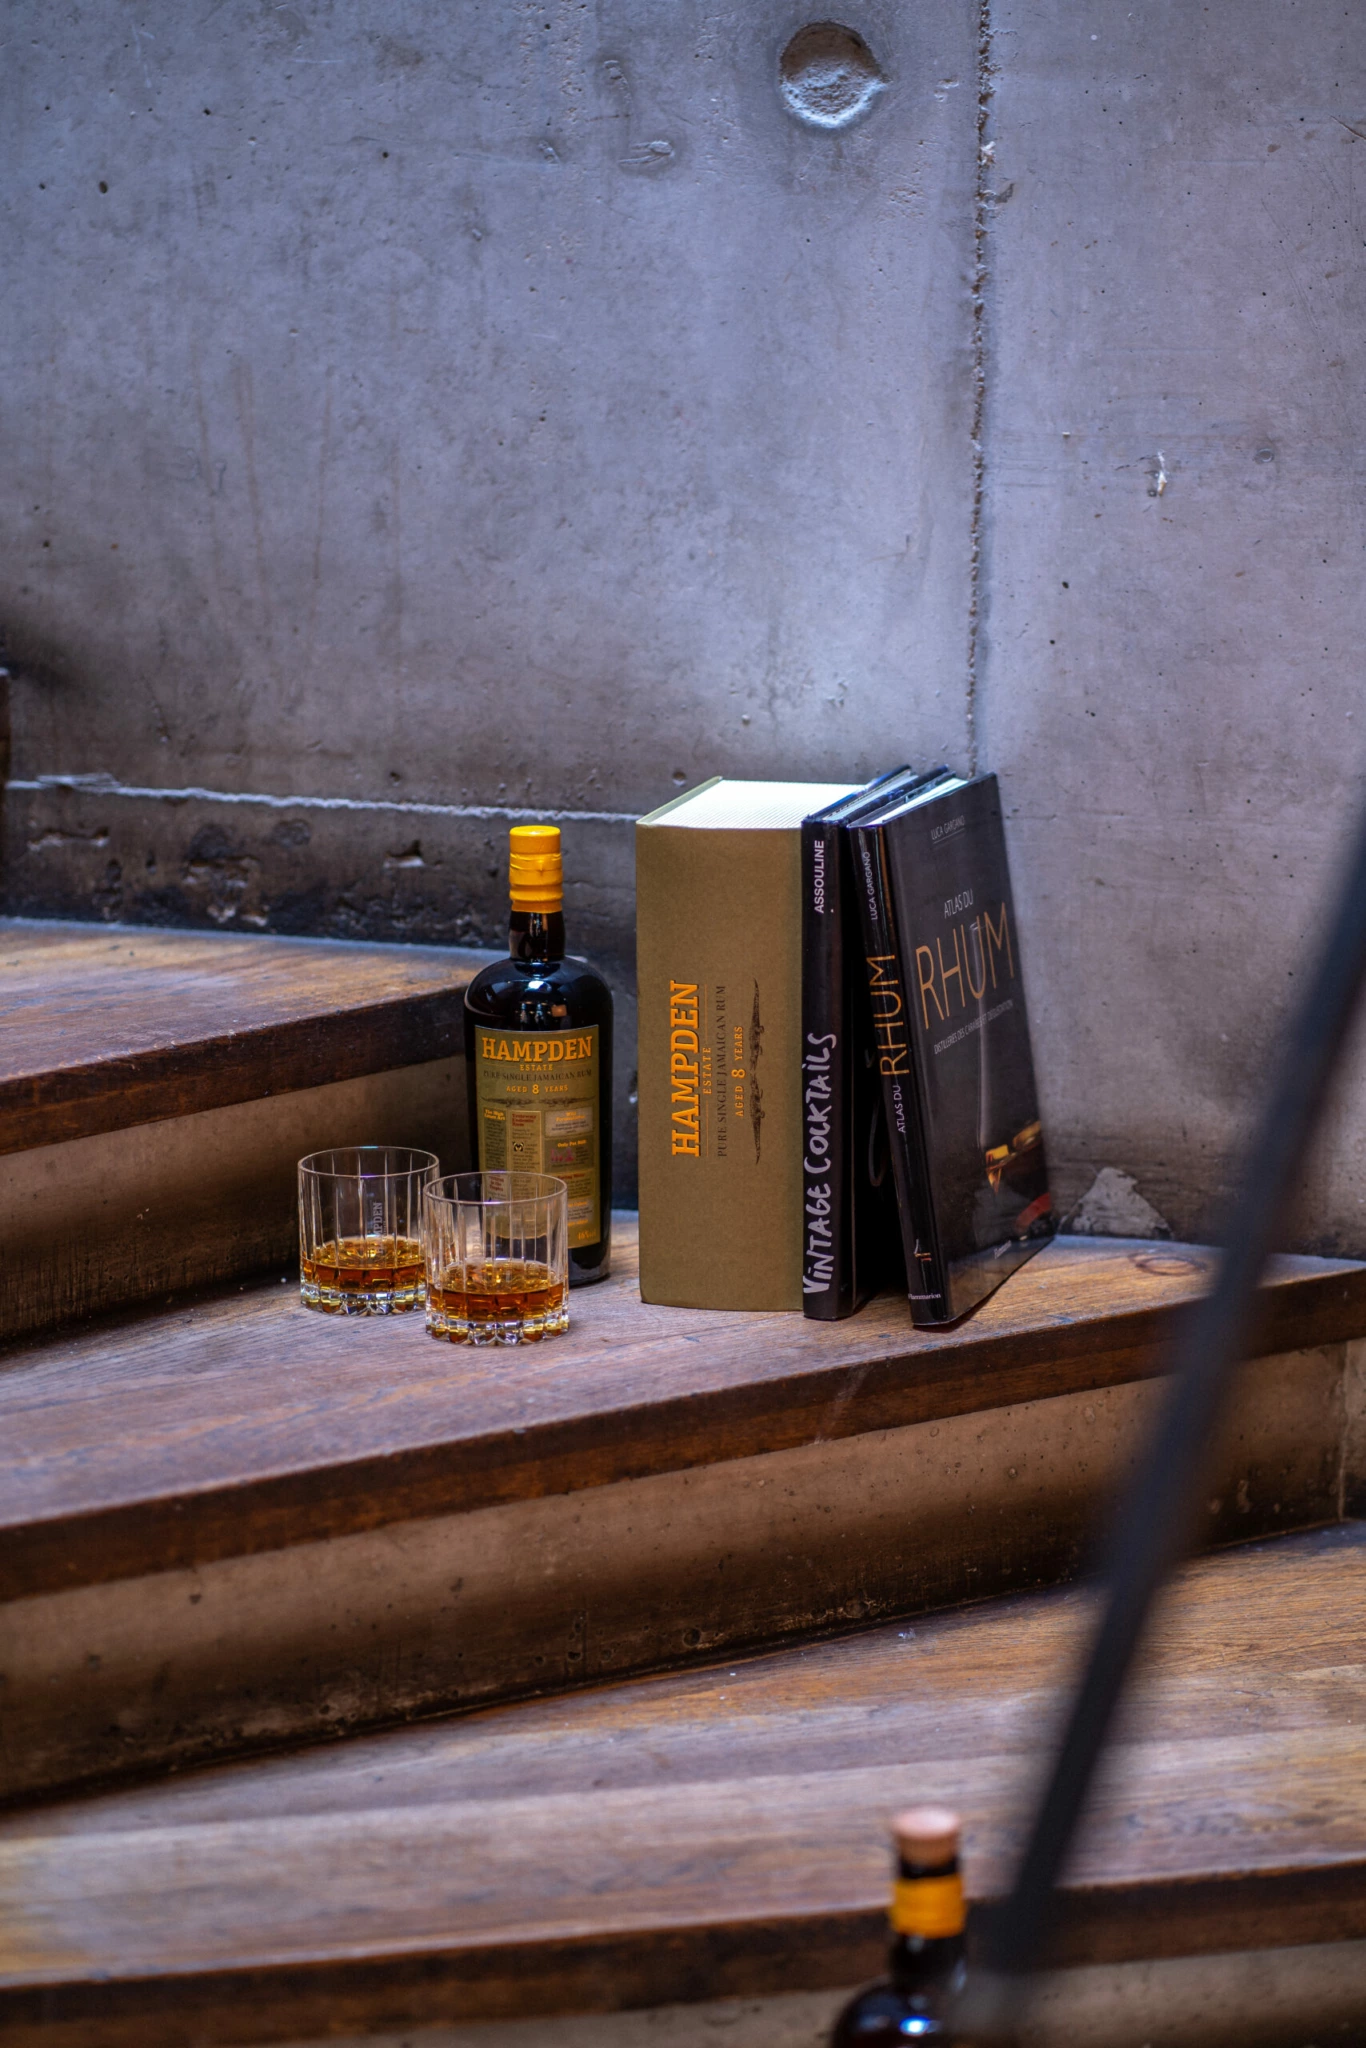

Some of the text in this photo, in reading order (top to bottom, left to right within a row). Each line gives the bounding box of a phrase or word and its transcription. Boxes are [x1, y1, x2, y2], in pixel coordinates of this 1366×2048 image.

[930, 824, 943, 841] LUCA
[814, 840, 825, 914] ASSOULINE
[862, 851, 875, 896] GARGANO
[944, 888, 974, 920] ATLAS DU
[915, 902, 1014, 1030] RHUM
[481, 1036, 593, 1063] HAMPDEN
[866, 954, 910, 1133] ATLAS DU RHUM
[503, 1072, 532, 1081] SINGLE
[533, 1072, 576, 1081] JAMAICAN
[577, 1068, 592, 1077] RUM
[506, 1083, 569, 1094] AGED 8 YEARS
[519, 1064, 554, 1072] ESTATE
[669, 979, 700, 1157] HAMPDEN
[702, 1047, 712, 1095] ESTATE
[715, 985, 728, 1157] PURE SINGLE JAMAICAN RUM
[731, 1026, 746, 1117] AGED 8 YEARS
